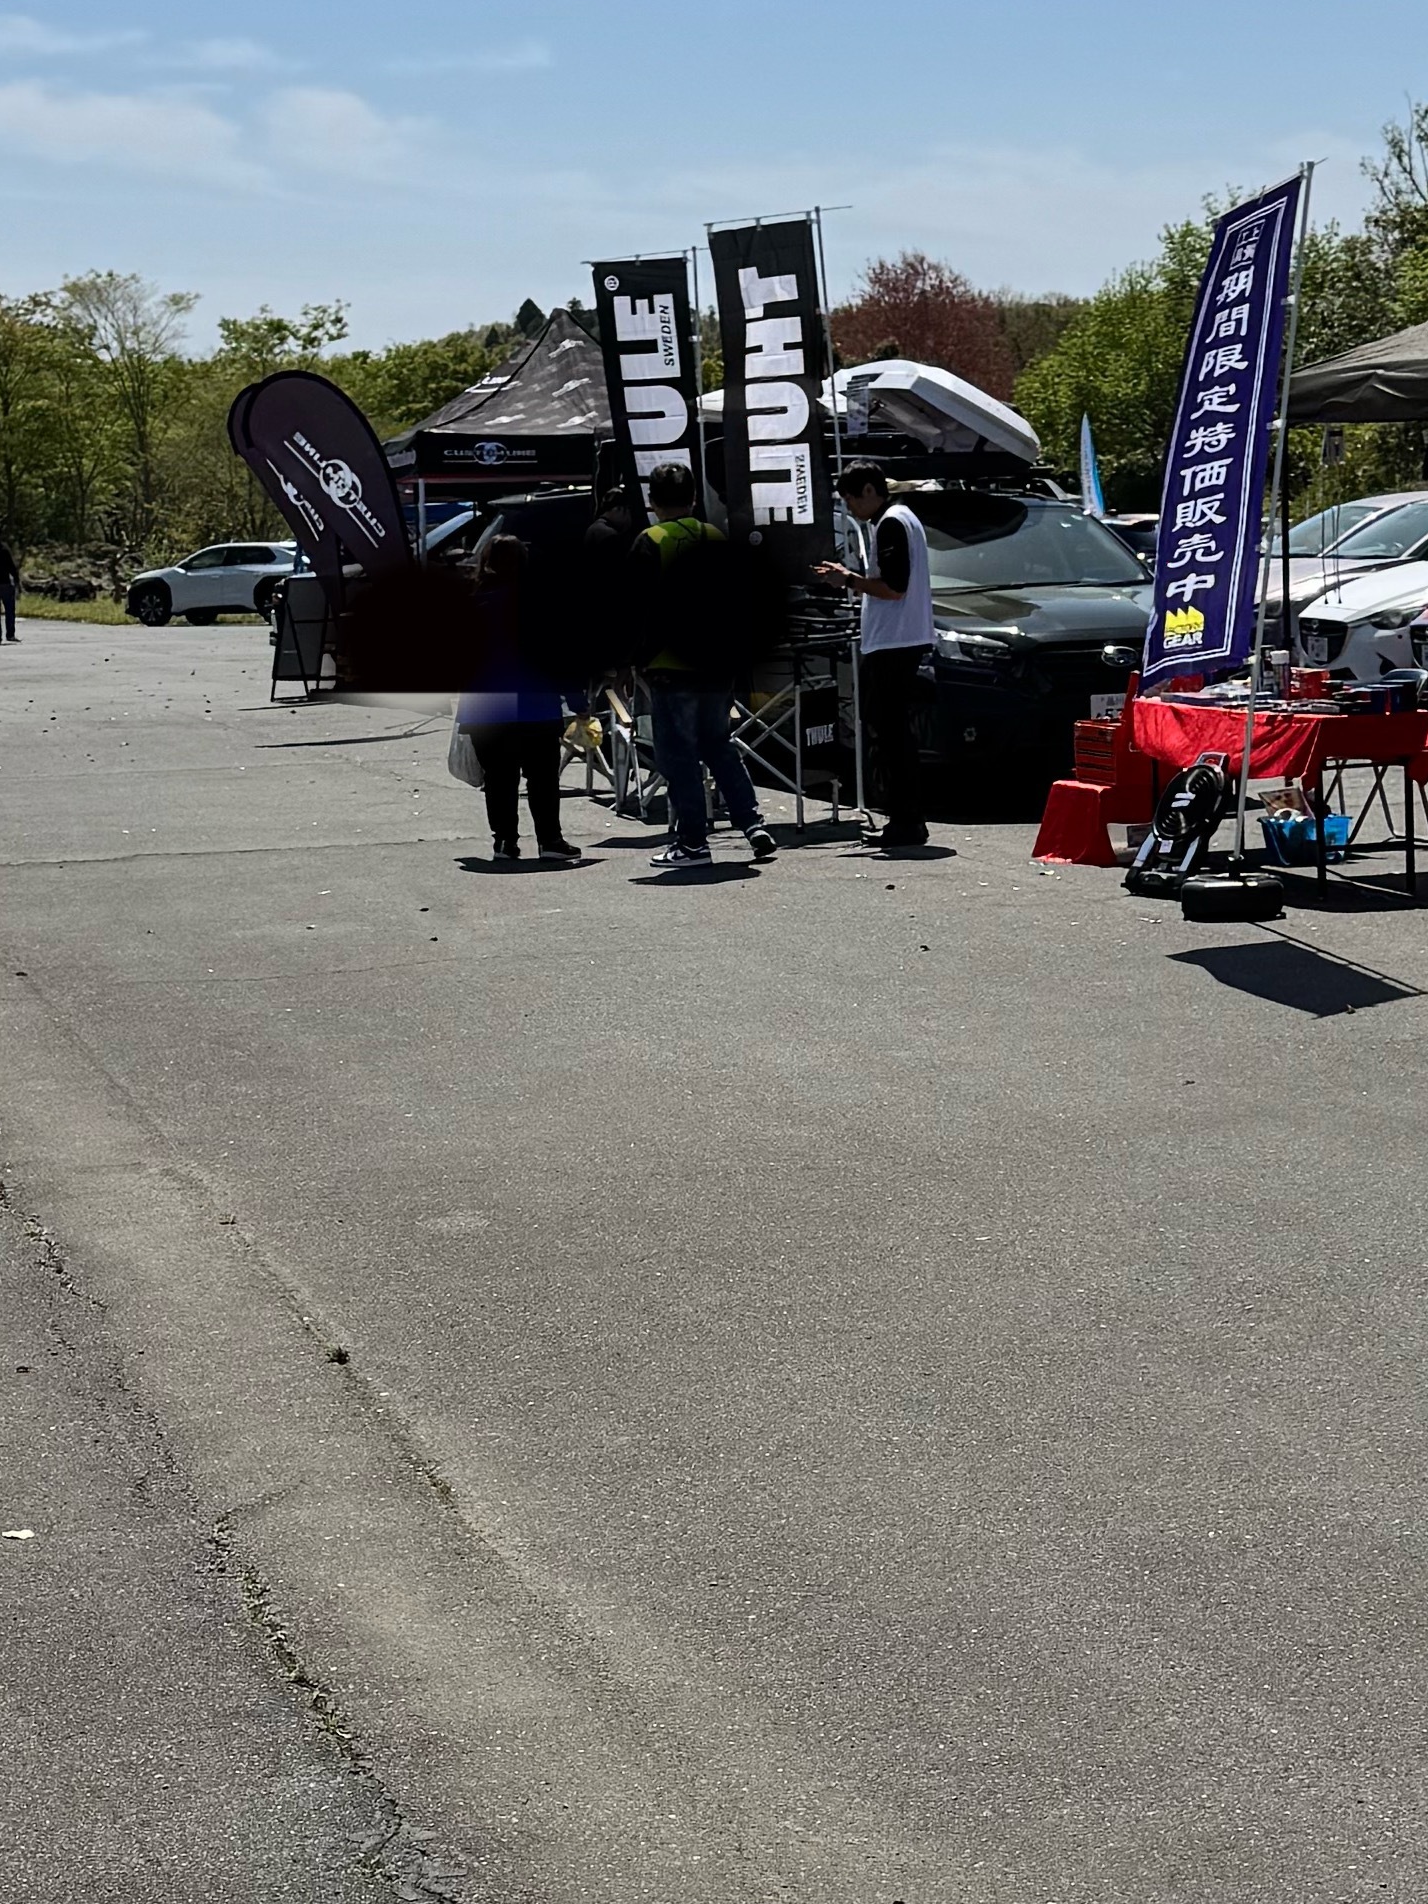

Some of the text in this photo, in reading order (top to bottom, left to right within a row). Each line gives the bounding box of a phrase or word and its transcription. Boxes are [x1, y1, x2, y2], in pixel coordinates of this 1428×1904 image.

[613, 293, 692, 526] HULE
[657, 304, 675, 367] SWEDEN
[1166, 265, 1255, 603] 期間限定特価販売中
[1163, 631, 1203, 649] GEAR
